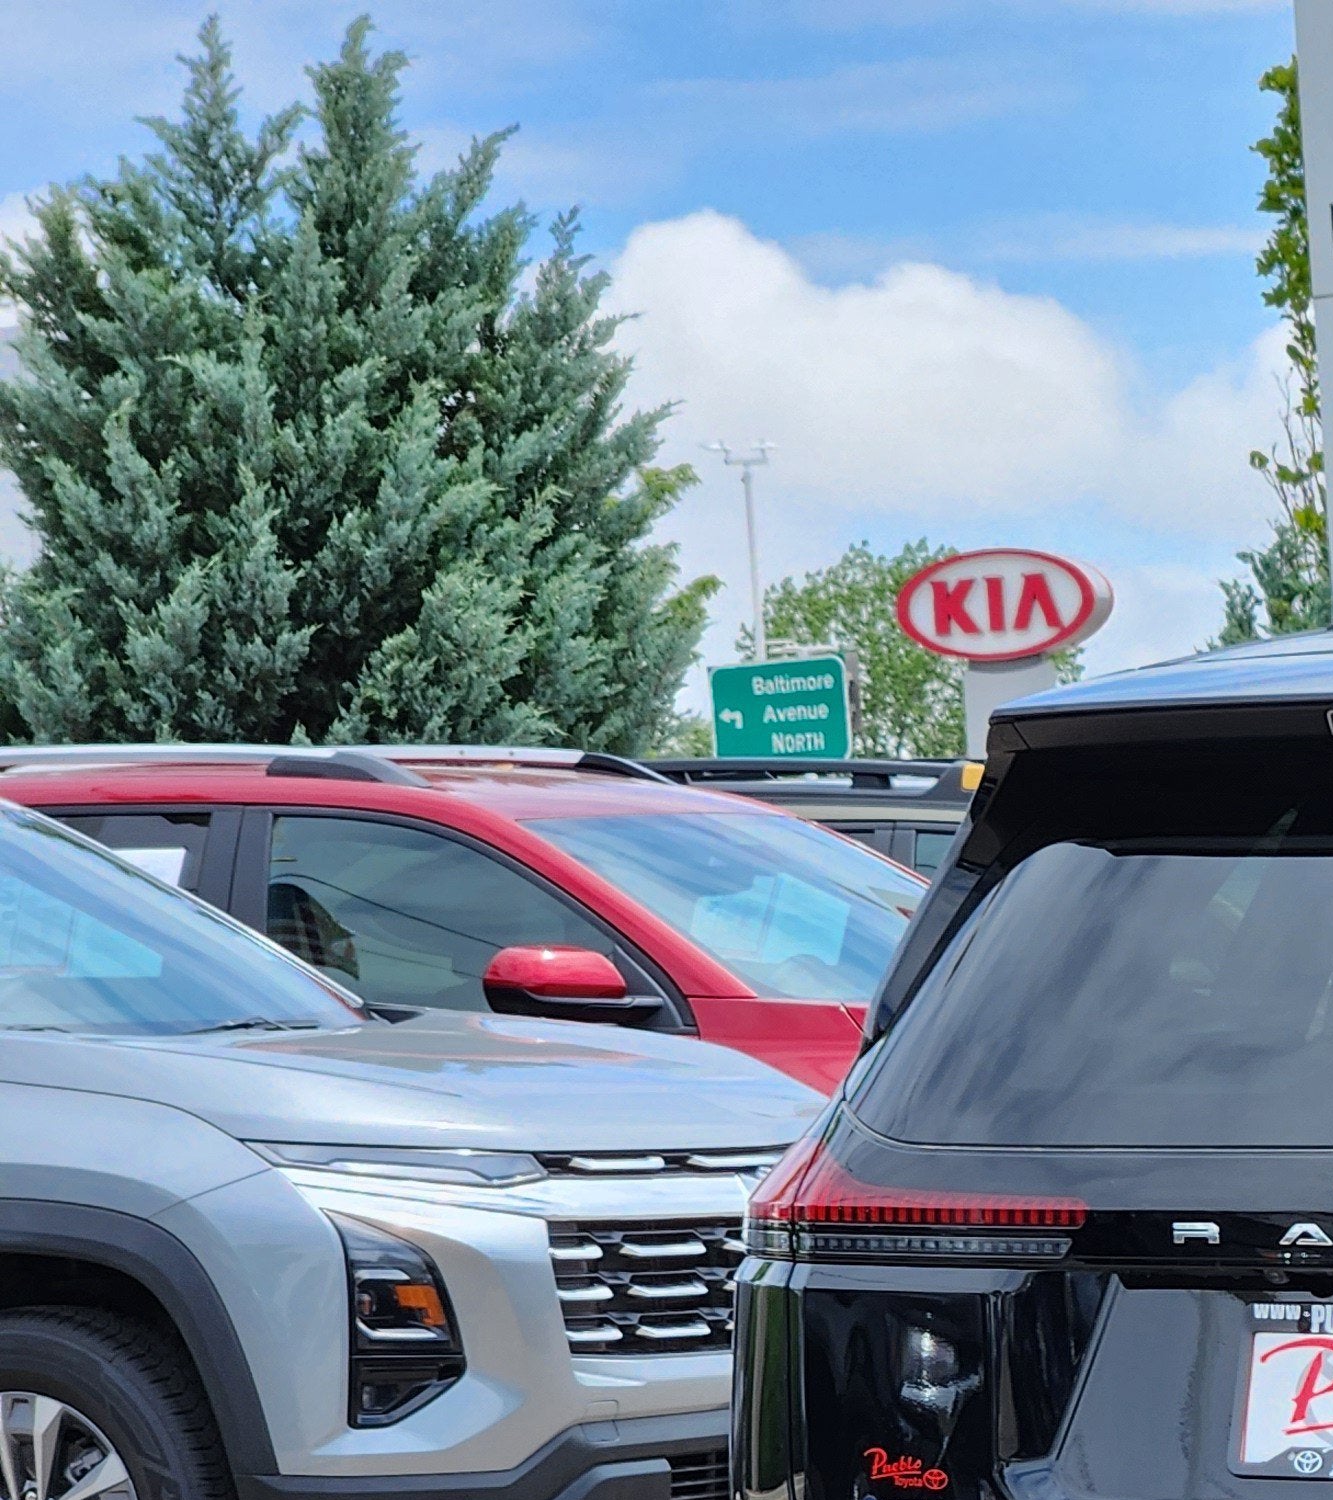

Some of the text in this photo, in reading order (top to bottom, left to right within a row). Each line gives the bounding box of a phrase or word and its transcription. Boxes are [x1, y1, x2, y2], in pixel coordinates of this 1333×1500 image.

[930, 572, 1063, 637] KIA
[751, 673, 835, 696] Baltimore
[763, 703, 830, 724] Avenue
[771, 731, 826, 754] NORTH
[863, 1447, 923, 1477] Pueblo
